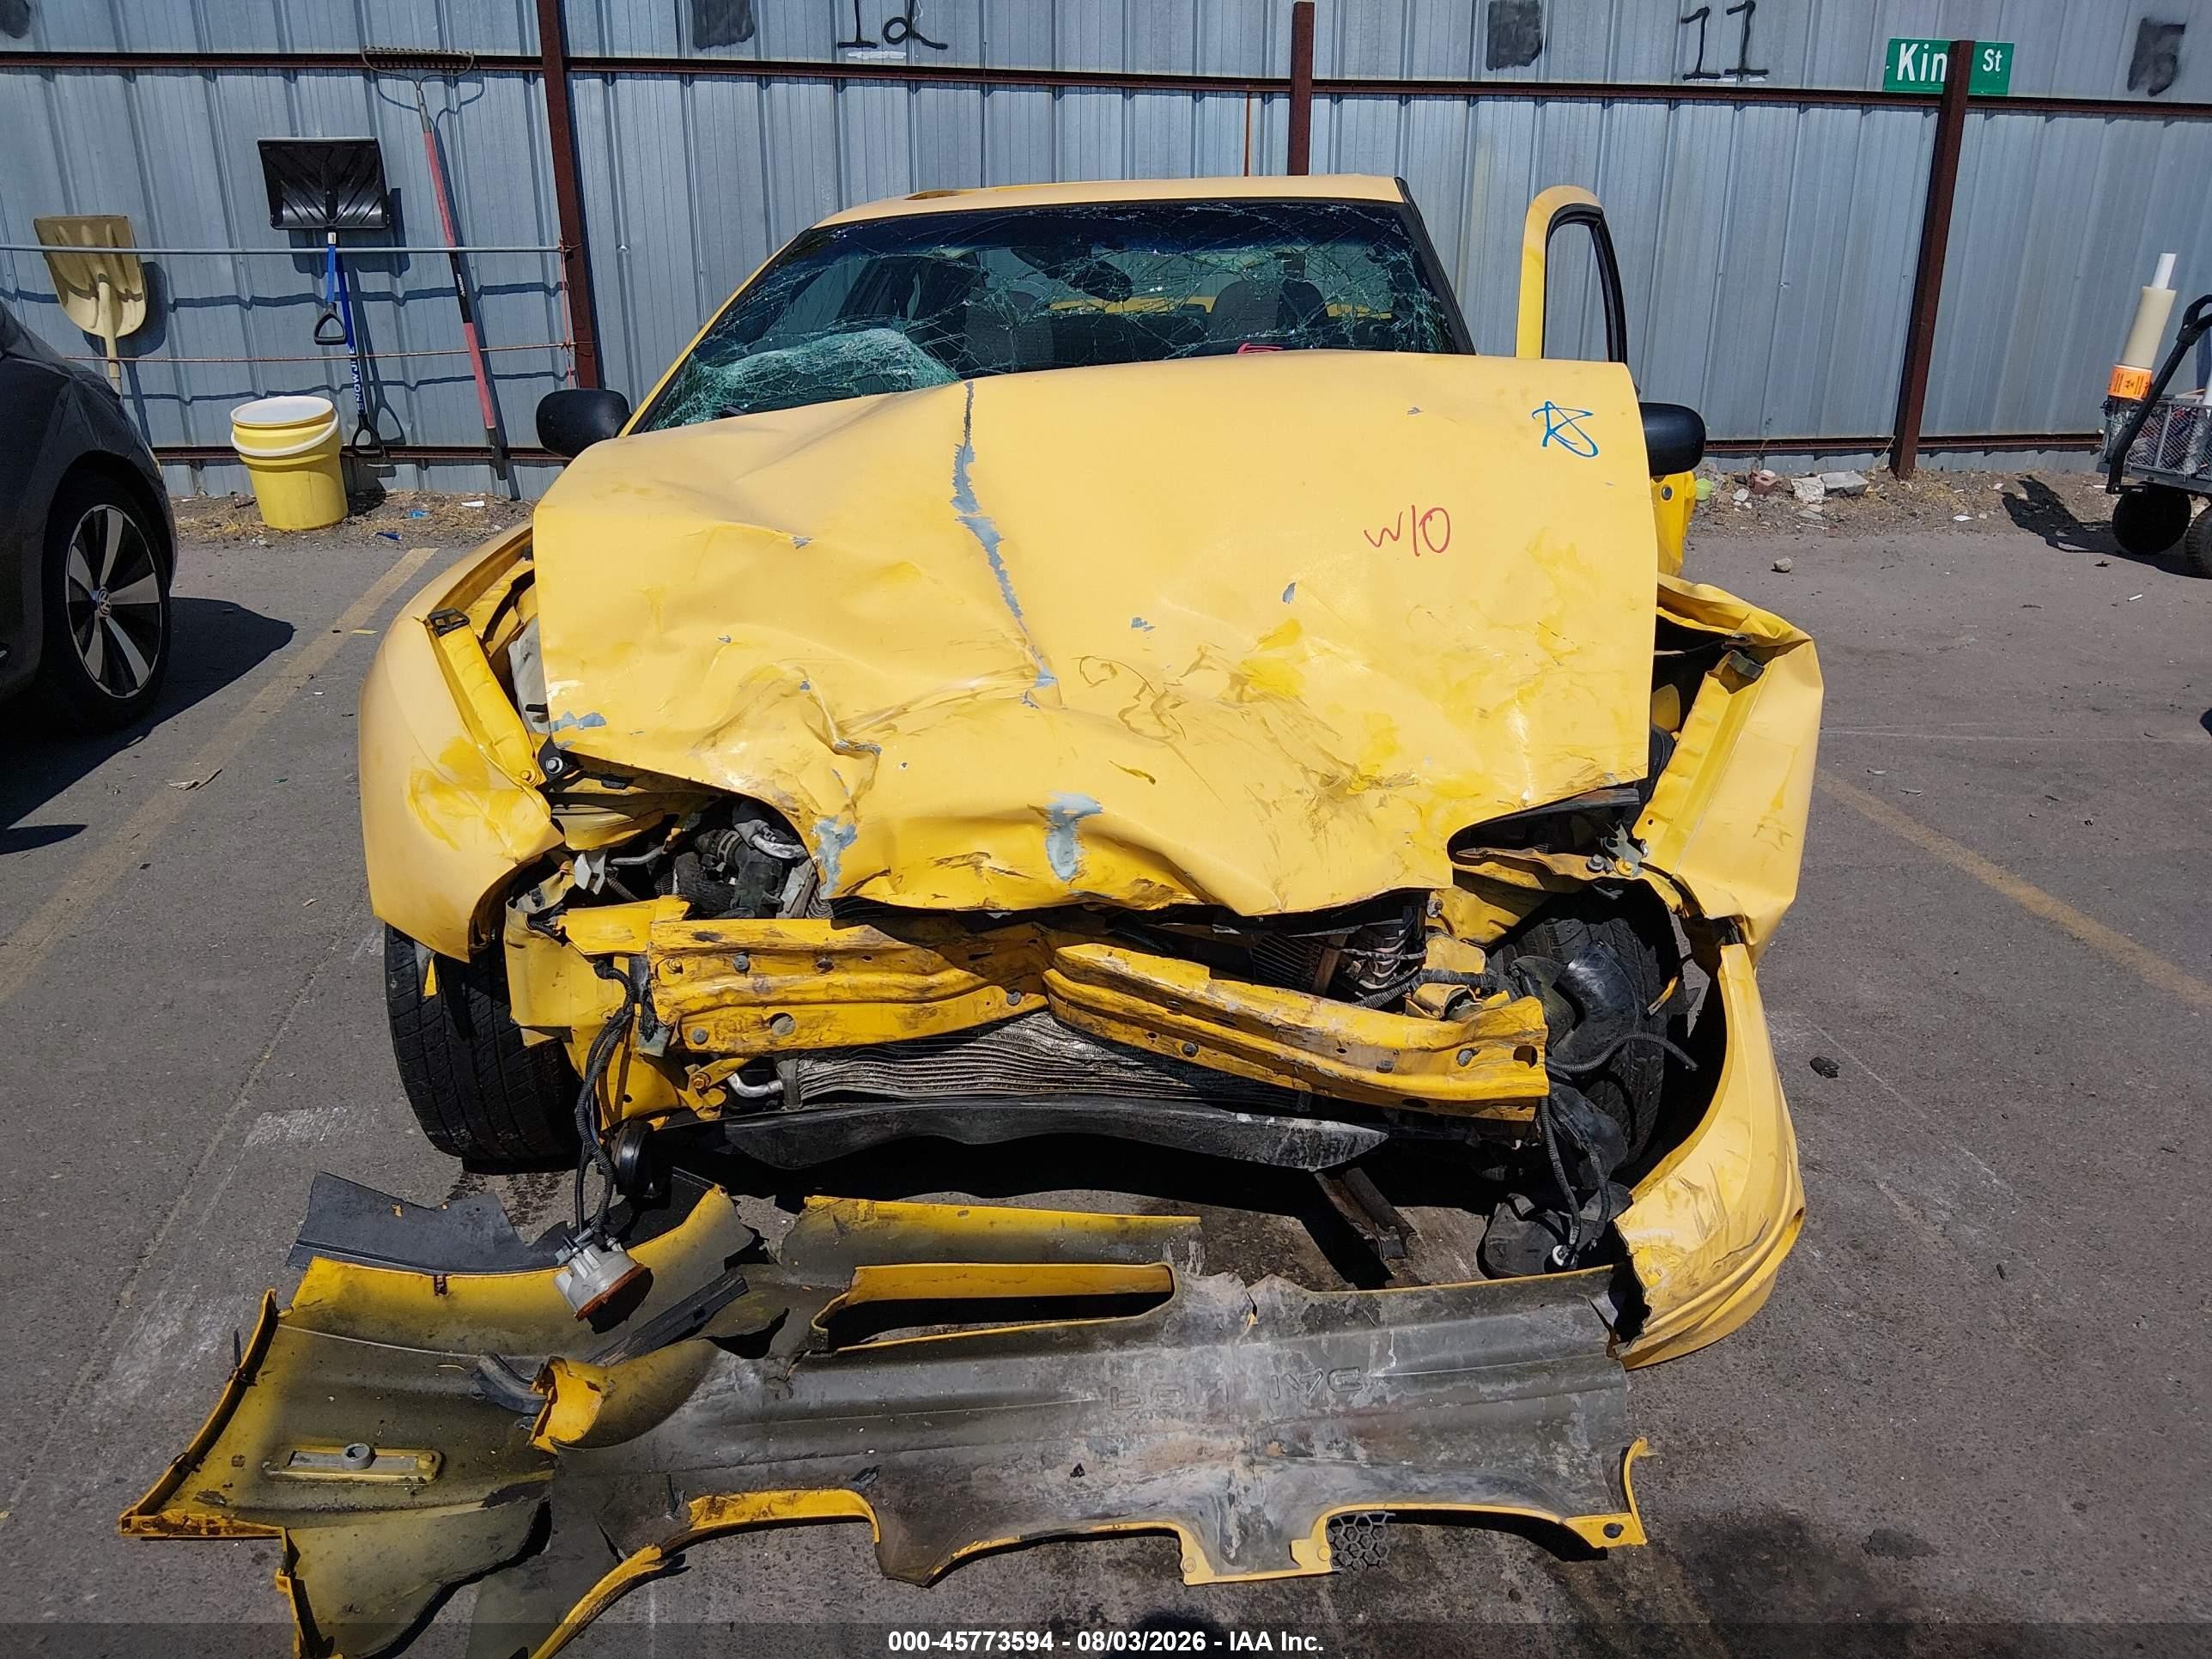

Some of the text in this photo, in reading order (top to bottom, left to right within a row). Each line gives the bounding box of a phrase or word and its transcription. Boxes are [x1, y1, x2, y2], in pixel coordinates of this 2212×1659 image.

[1680, 0, 1769, 79] 11
[1897, 43, 2002, 82] Kin St
